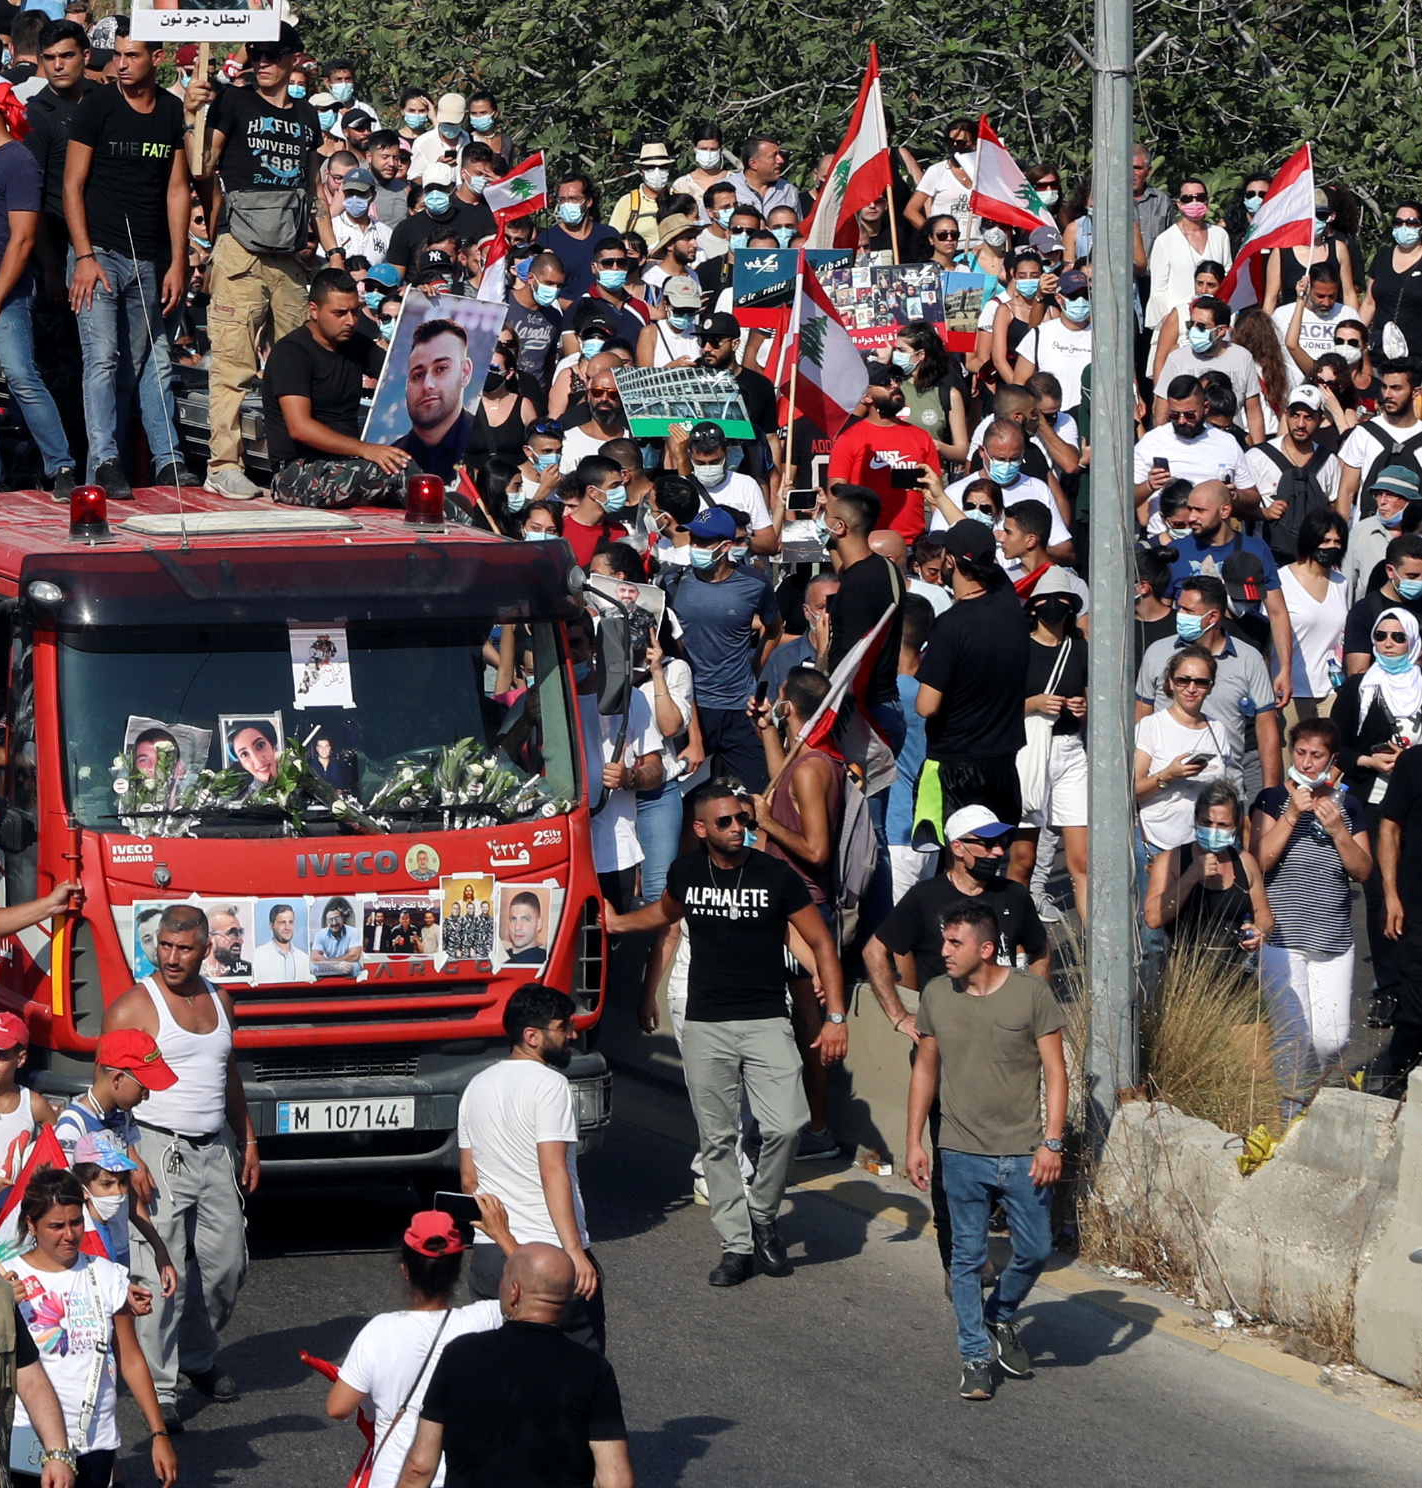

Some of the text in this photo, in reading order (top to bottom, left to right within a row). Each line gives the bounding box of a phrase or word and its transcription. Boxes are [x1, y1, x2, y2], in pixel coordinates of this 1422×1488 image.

[160, 13, 251, 27] البطل دجو نون
[109, 141, 172, 159] THE FATE
[247, 137, 301, 156] UNIVERS
[876, 451, 899, 462] JUST
[111, 844, 153, 855] IVECO
[112, 854, 154, 863] MAGIRUS
[296, 849, 399, 878] IVECO
[372, 898, 396, 910] بأبطالها
[685, 887, 769, 907] ALPHALETE
[398, 901, 416, 910] تفتخر
[692, 908, 759, 918] ATHLEICS
[294, 1104, 400, 1130] M 107144
[89, 1266, 97, 1286] MARC
[71, 1339, 97, 1347] DAISY
[92, 1357, 101, 1390] JACOBS
